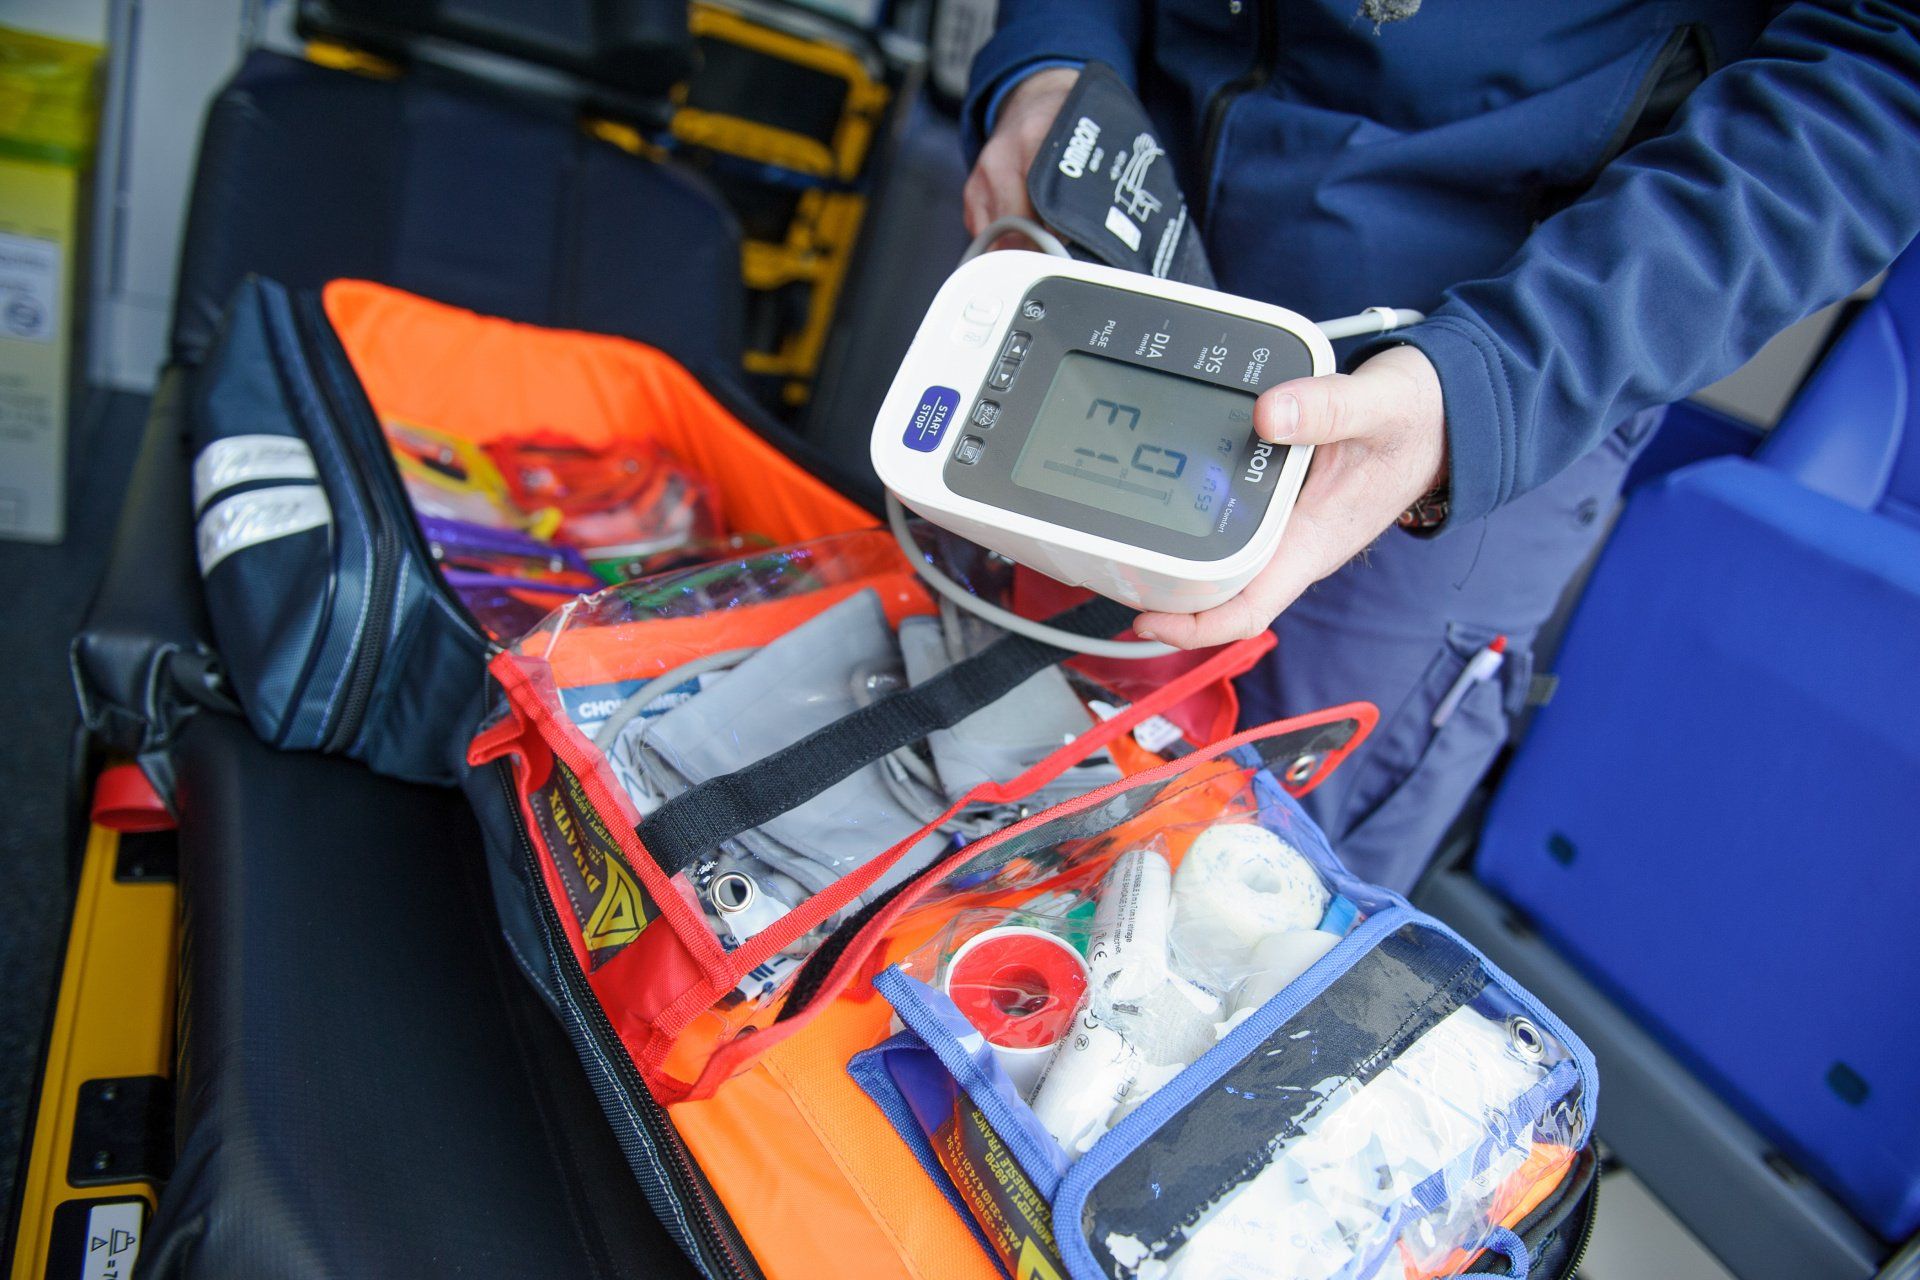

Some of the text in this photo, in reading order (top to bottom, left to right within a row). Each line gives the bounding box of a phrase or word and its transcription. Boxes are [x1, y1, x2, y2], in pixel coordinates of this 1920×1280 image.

[1089, 329, 1101, 346] /min
[1097, 319, 1116, 348] PULSE
[1135, 333, 1150, 356] mmHg
[1146, 332, 1170, 359] DIA
[1193, 347, 1209, 370] mmHg
[1205, 345, 1228, 374] SYS
[1242, 361, 1256, 383] sense
[1250, 363, 1265, 385] Intelli
[914, 403, 932, 429] STOP
[928, 405, 948, 436] START
[1244, 439, 1273, 483] RON
[1217, 497, 1237, 533] M6 Comfort
[549, 787, 601, 893] DIMATEX
[972, 1109, 1001, 1151] FRANCE
[984, 1151, 1010, 1187] 69210
[999, 1156, 1050, 1223] L'ARBRESLE
[1011, 1193, 1053, 1245] MONTEPY
